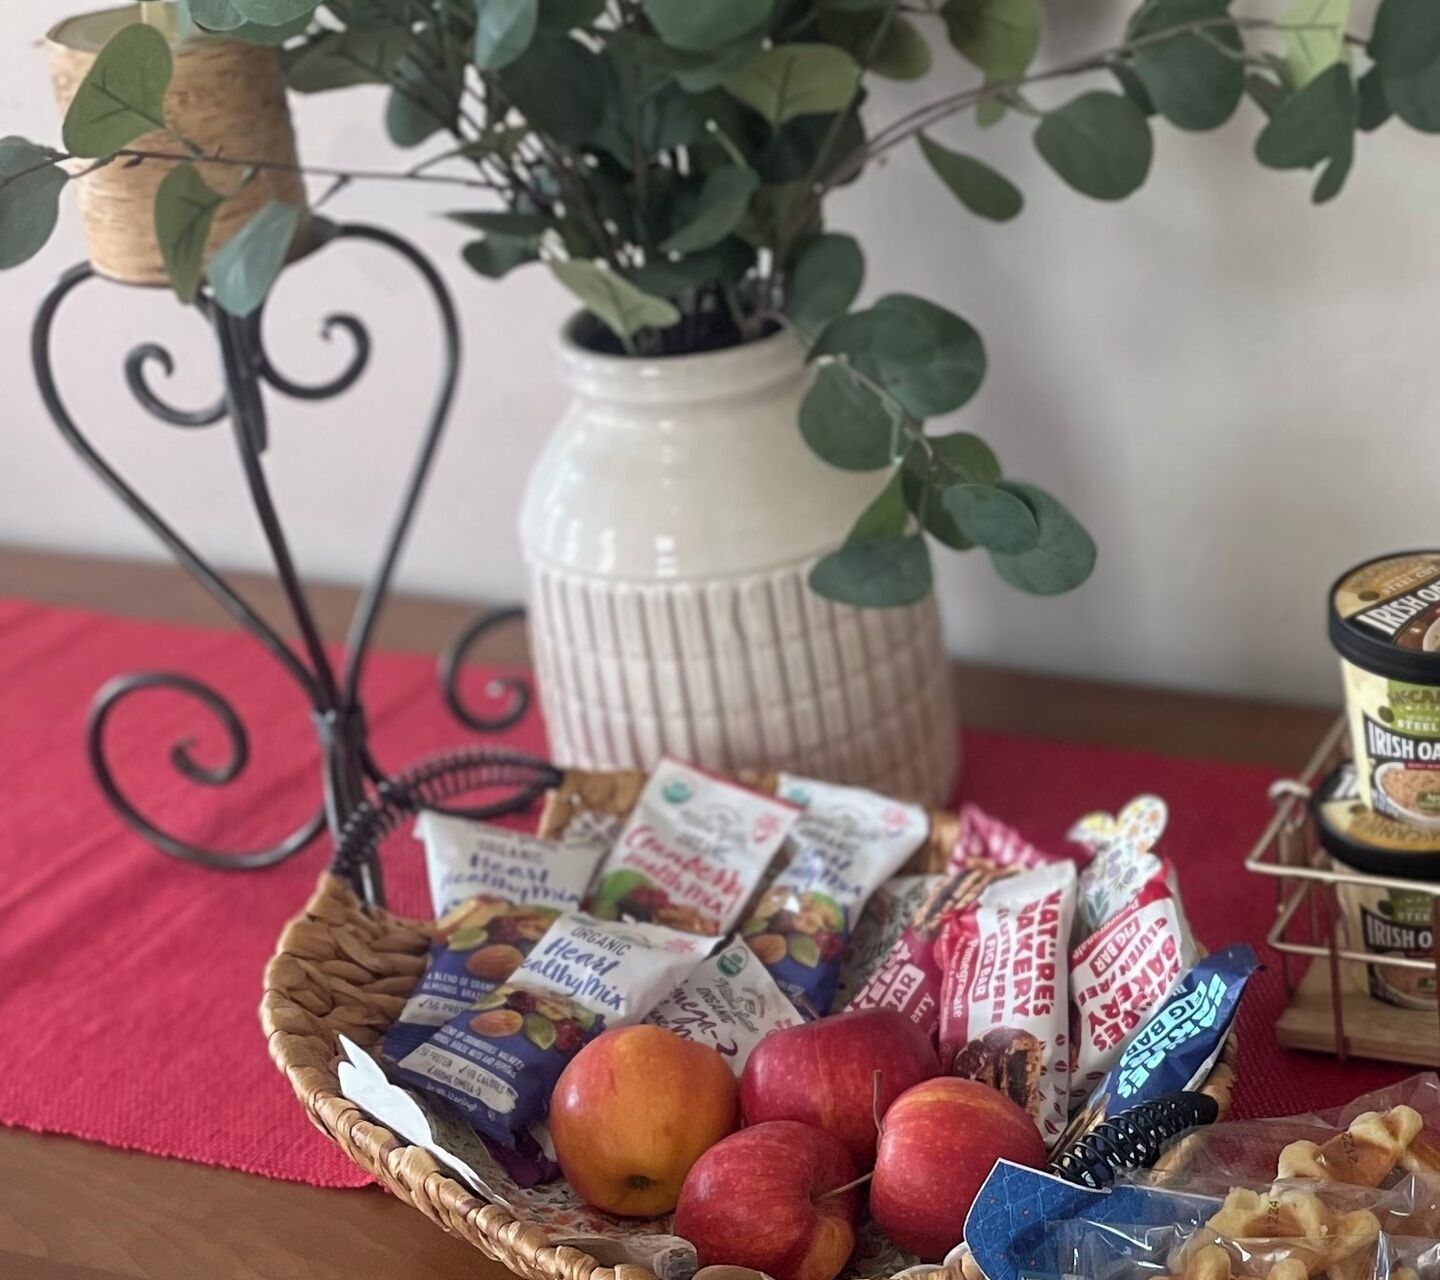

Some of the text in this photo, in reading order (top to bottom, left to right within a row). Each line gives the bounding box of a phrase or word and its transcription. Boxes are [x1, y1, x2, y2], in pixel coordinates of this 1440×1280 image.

[1356, 592, 1427, 635] IRISH
[1368, 721, 1414, 759] IRISH
[1398, 721, 1438, 732] STEEL
[570, 926, 631, 957] ORGANIC
[1092, 919, 1138, 972] FIG BAR
[1366, 914, 1417, 947] IRISH
[543, 937, 620, 975] Heart
[973, 933, 997, 1000] FIG BAR
[991, 972, 1008, 1024] FREE
[1168, 990, 1204, 1021] FIG
